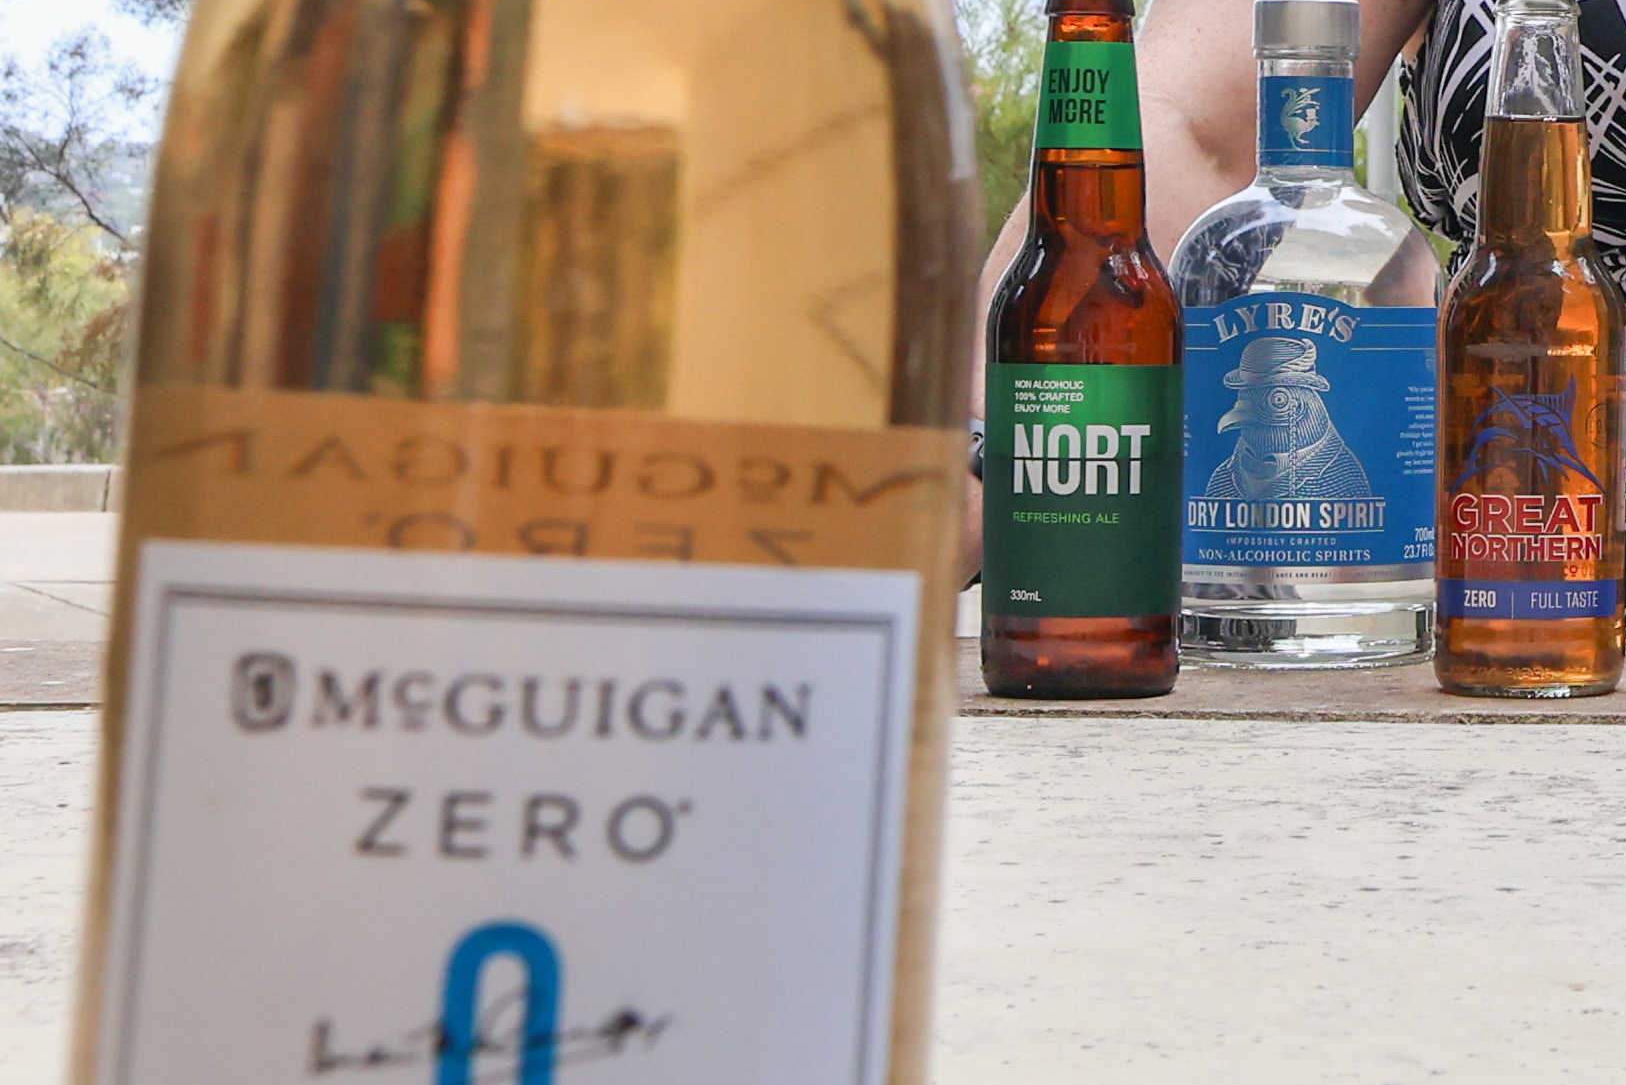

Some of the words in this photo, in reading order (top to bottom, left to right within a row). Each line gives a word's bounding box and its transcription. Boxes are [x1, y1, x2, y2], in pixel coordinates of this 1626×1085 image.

[1048, 69, 1110, 94] ENJOY
[1048, 99, 1106, 125] MORE
[1212, 302, 1361, 344] LYRE'S
[1014, 379, 1032, 389] NON
[1033, 380, 1085, 390] ALCOHOLIC
[1014, 391, 1037, 401] 100%
[1038, 392, 1085, 402] CRAFTED
[1014, 403, 1041, 413] ENJOY
[1042, 404, 1071, 414] MORE
[1013, 423, 1151, 495] NORT
[1013, 512, 1091, 524] REFRESHING
[1095, 513, 1119, 524] ALE
[1188, 501, 1219, 527] DRY
[1226, 501, 1311, 528] LONDON
[1319, 501, 1386, 528] SPIRIT
[1451, 493, 1603, 534] GREAT
[1226, 536, 1285, 546] IMPOSSIBLY
[1289, 537, 1337, 546] CRAFTED
[1451, 532, 1603, 562] NORTHERN
[1198, 549, 1311, 562] NON-ALCOHOLIC
[1315, 548, 1371, 562] SPIRITS
[1010, 589, 1042, 602] 330mL
[1463, 589, 1497, 608] ZERO
[1530, 591, 1562, 609] FULL
[1565, 590, 1599, 608] TASTE
[354, 787, 677, 866] ZERO
